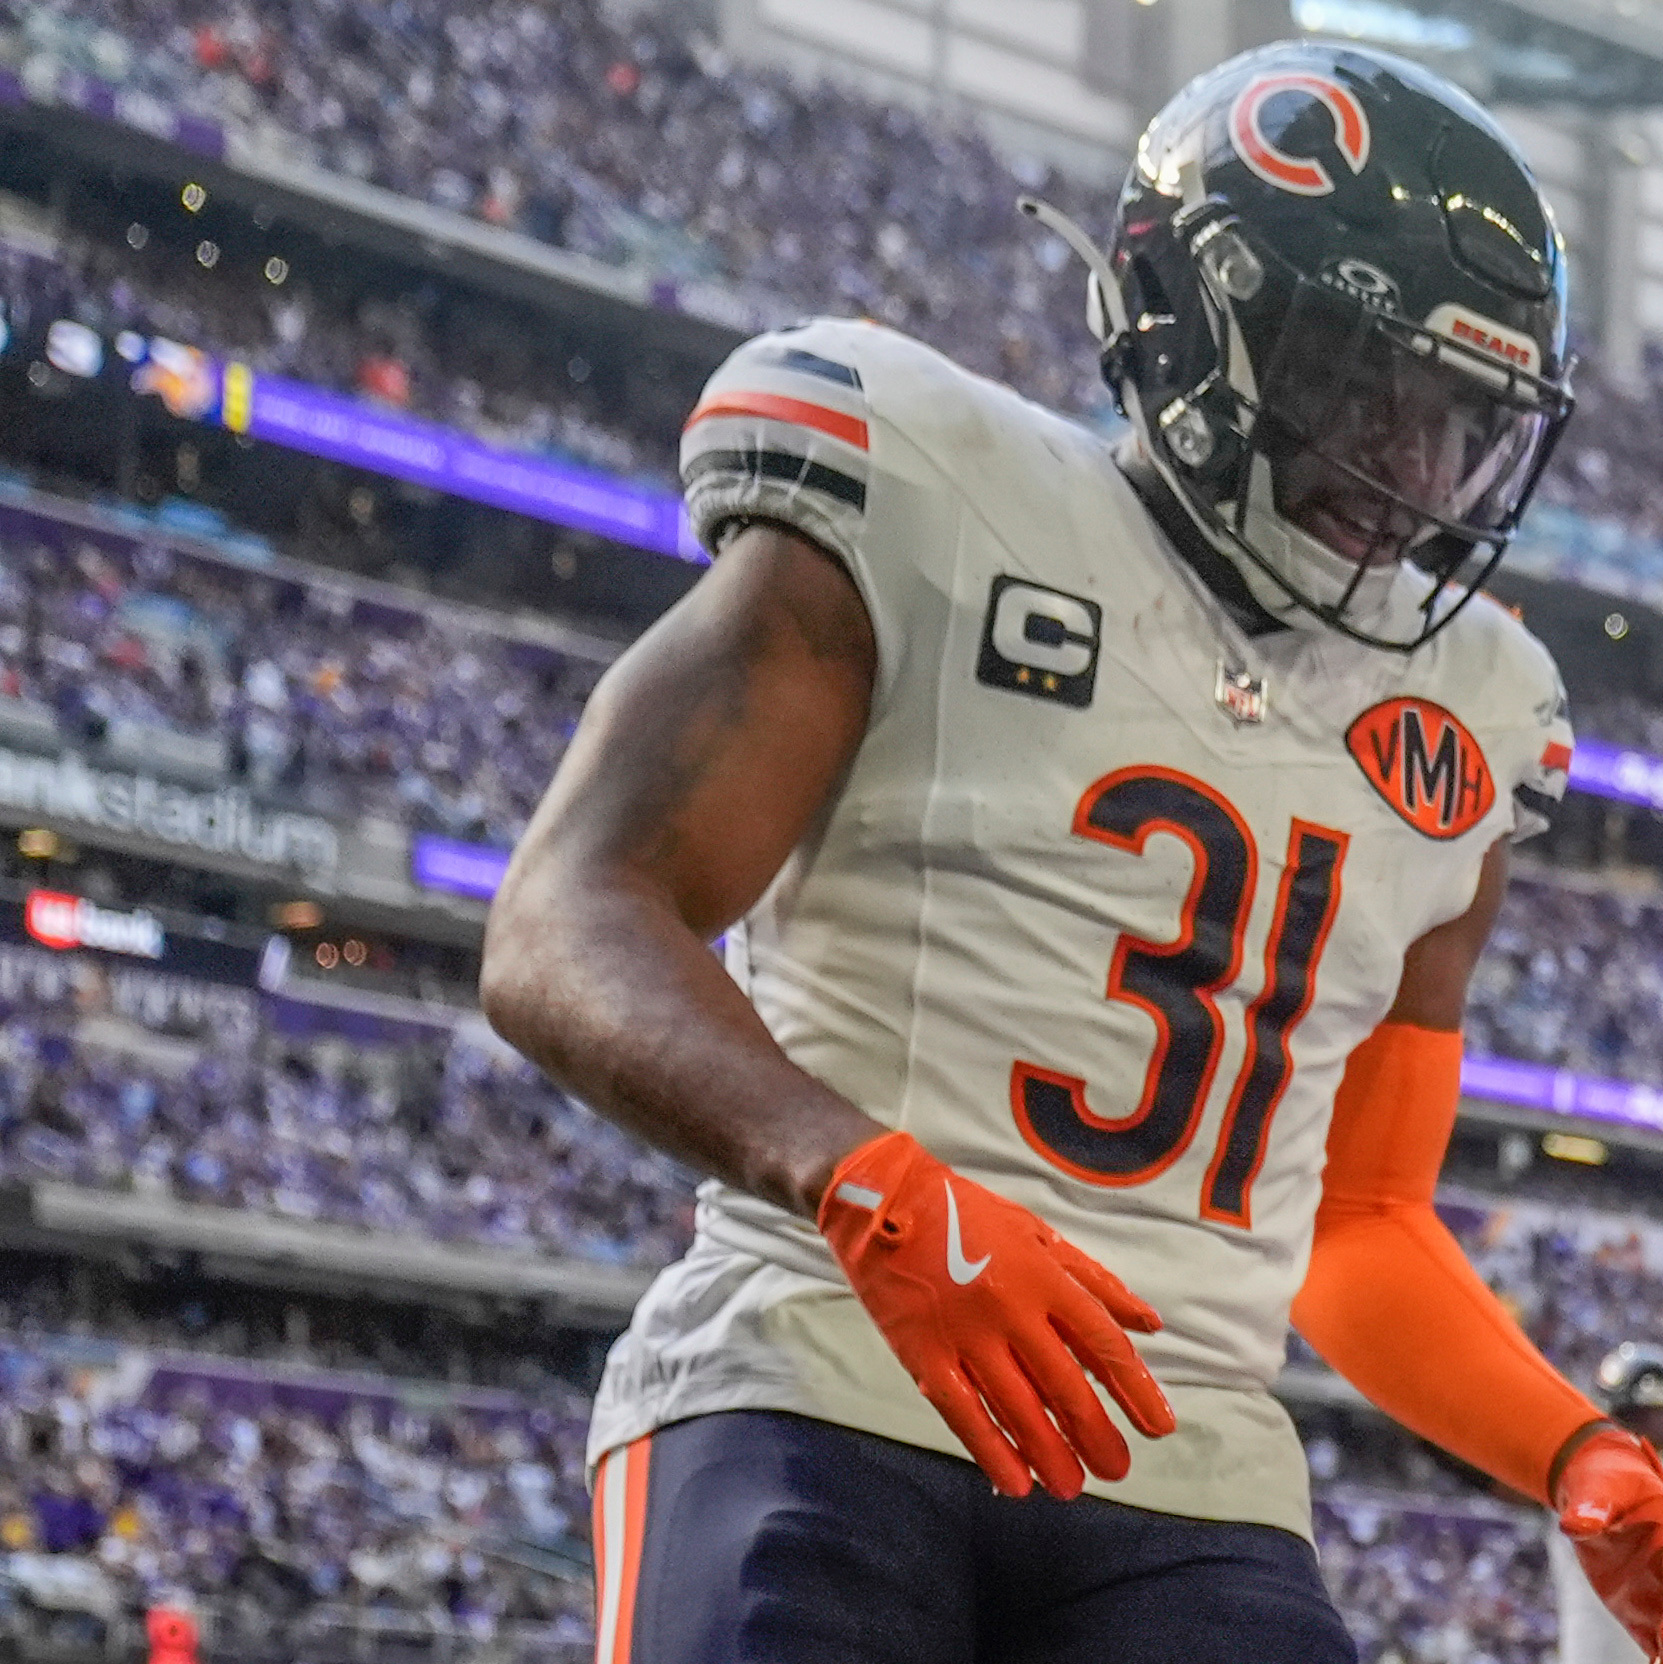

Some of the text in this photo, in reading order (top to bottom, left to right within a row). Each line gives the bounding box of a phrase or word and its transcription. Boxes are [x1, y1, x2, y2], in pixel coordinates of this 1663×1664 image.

[1452, 318, 1530, 366] BEARS
[992, 584, 1096, 677] C
[1011, 764, 1350, 1230] 31
